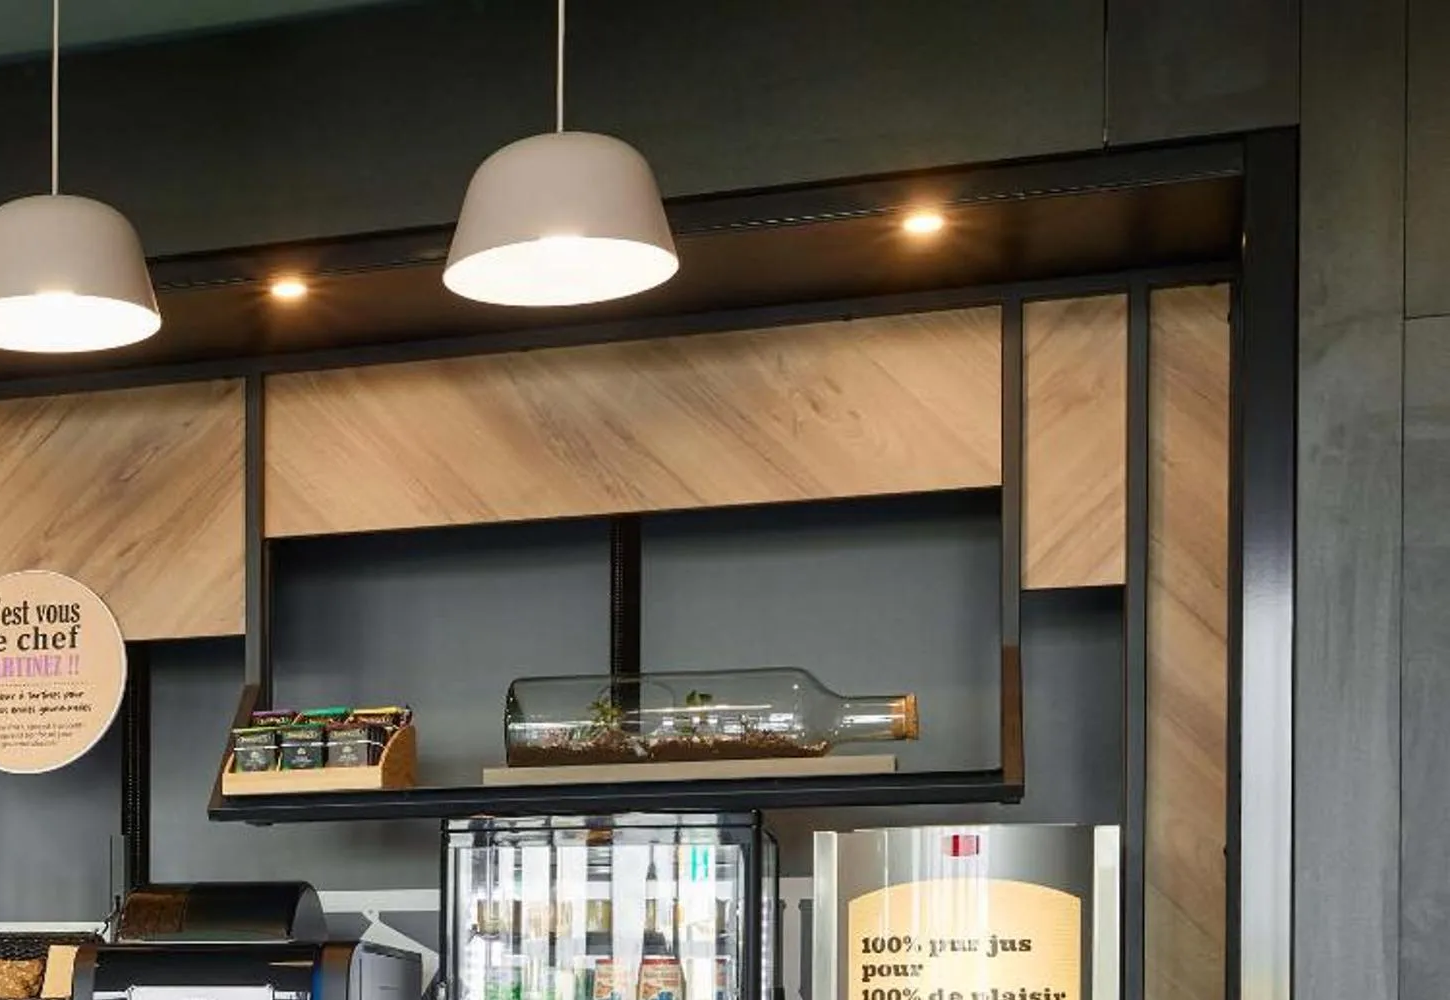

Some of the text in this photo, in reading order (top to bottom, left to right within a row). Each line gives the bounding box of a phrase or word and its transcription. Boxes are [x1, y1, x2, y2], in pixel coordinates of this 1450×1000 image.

[36, 600, 81, 624] vous
[17, 624, 81, 651] chef
[862, 934, 1032, 957] 100% pur jus
[862, 963, 924, 983] pour
